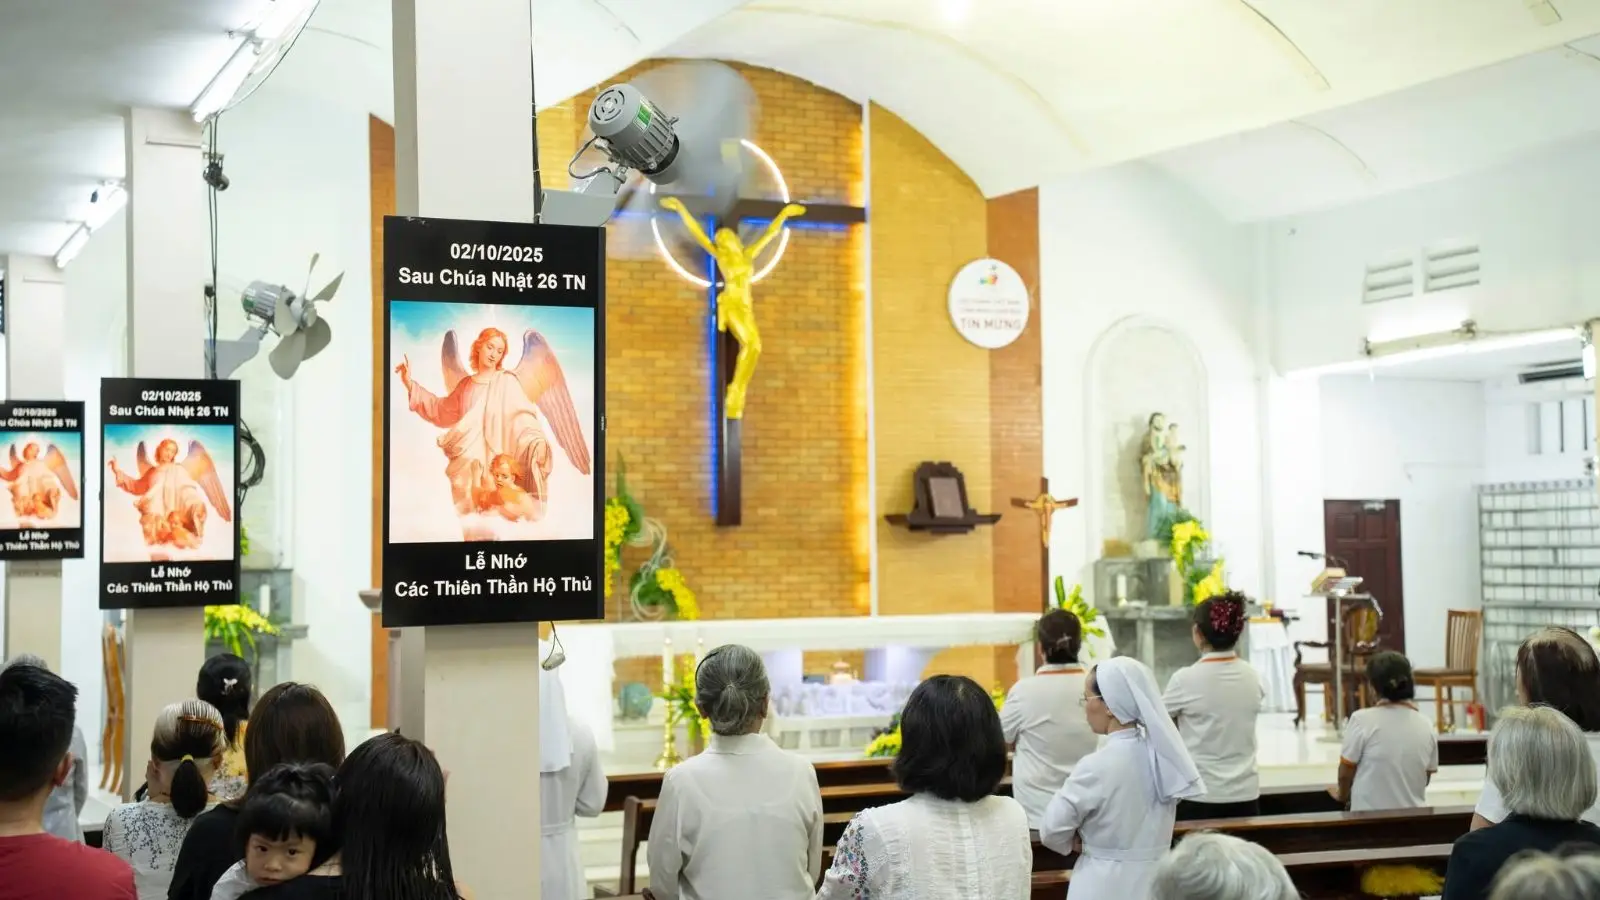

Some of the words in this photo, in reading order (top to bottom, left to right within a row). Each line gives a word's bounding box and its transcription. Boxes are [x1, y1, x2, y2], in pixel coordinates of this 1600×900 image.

[450, 243, 544, 262] 02/10/2025
[399, 267, 434, 285] Sau
[439, 269, 486, 287] Chúa
[492, 271, 533, 292] Nhật
[537, 274, 558, 289] 26
[563, 274, 586, 290] TN
[961, 318, 980, 329] TIN
[141, 390, 202, 402] 02/10/2025
[109, 405, 132, 416] Sau
[134, 405, 165, 416] Chúa
[168, 405, 195, 419] Nhật
[196, 406, 211, 417] 26
[213, 406, 229, 417] TN
[465, 551, 486, 570] Lễ
[491, 553, 528, 569] Nhớ
[151, 565, 165, 578] Lễ
[167, 567, 192, 577] Nhớ
[107, 583, 129, 593] Các
[131, 582, 162, 592] Thiên
[164, 579, 192, 592] Thần
[194, 581, 210, 593] Hộ
[212, 580, 233, 591] Thủ
[394, 581, 429, 597] Các
[434, 580, 481, 596] Thiên
[487, 574, 528, 595] Thần
[533, 577, 557, 596] Hộ
[561, 576, 592, 592] Thủ
